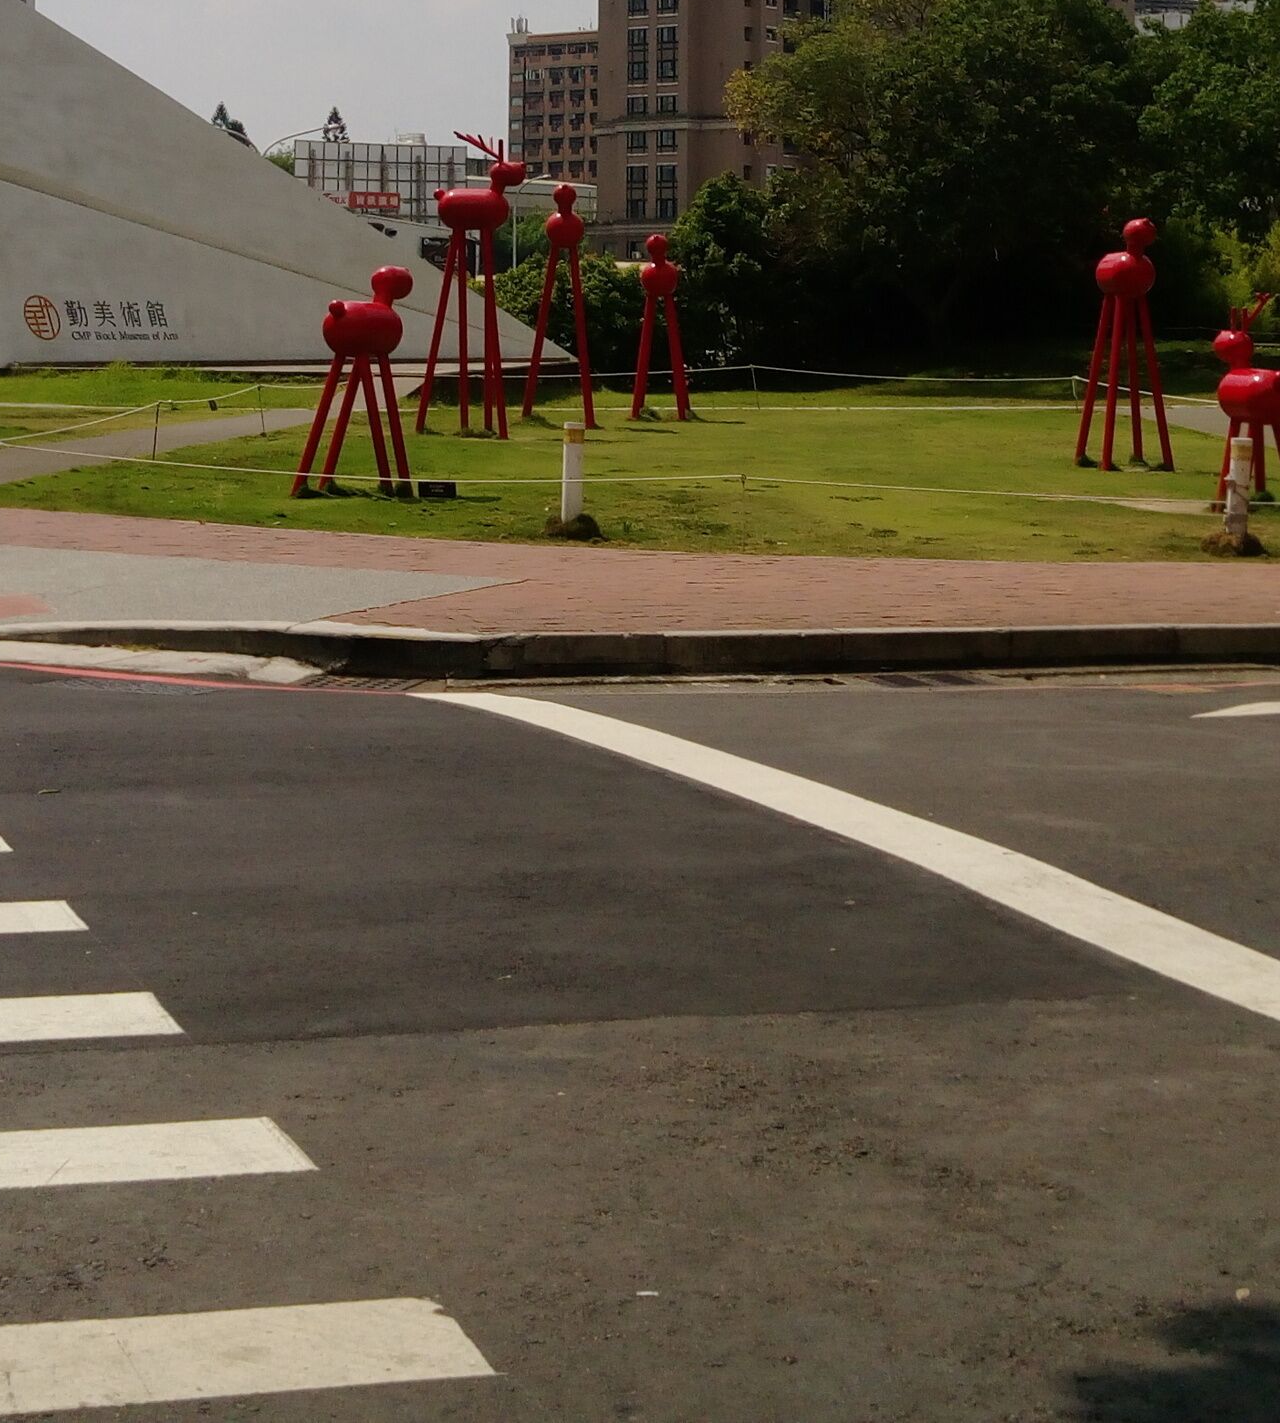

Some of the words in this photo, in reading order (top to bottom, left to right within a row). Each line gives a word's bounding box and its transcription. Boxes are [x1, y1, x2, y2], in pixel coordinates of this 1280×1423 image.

[63, 299, 169, 328] 勤美術館
[71, 330, 91, 341] CMP
[120, 330, 150, 341] Museum
[152, 330, 160, 341] of
[163, 330, 179, 341] Arts
